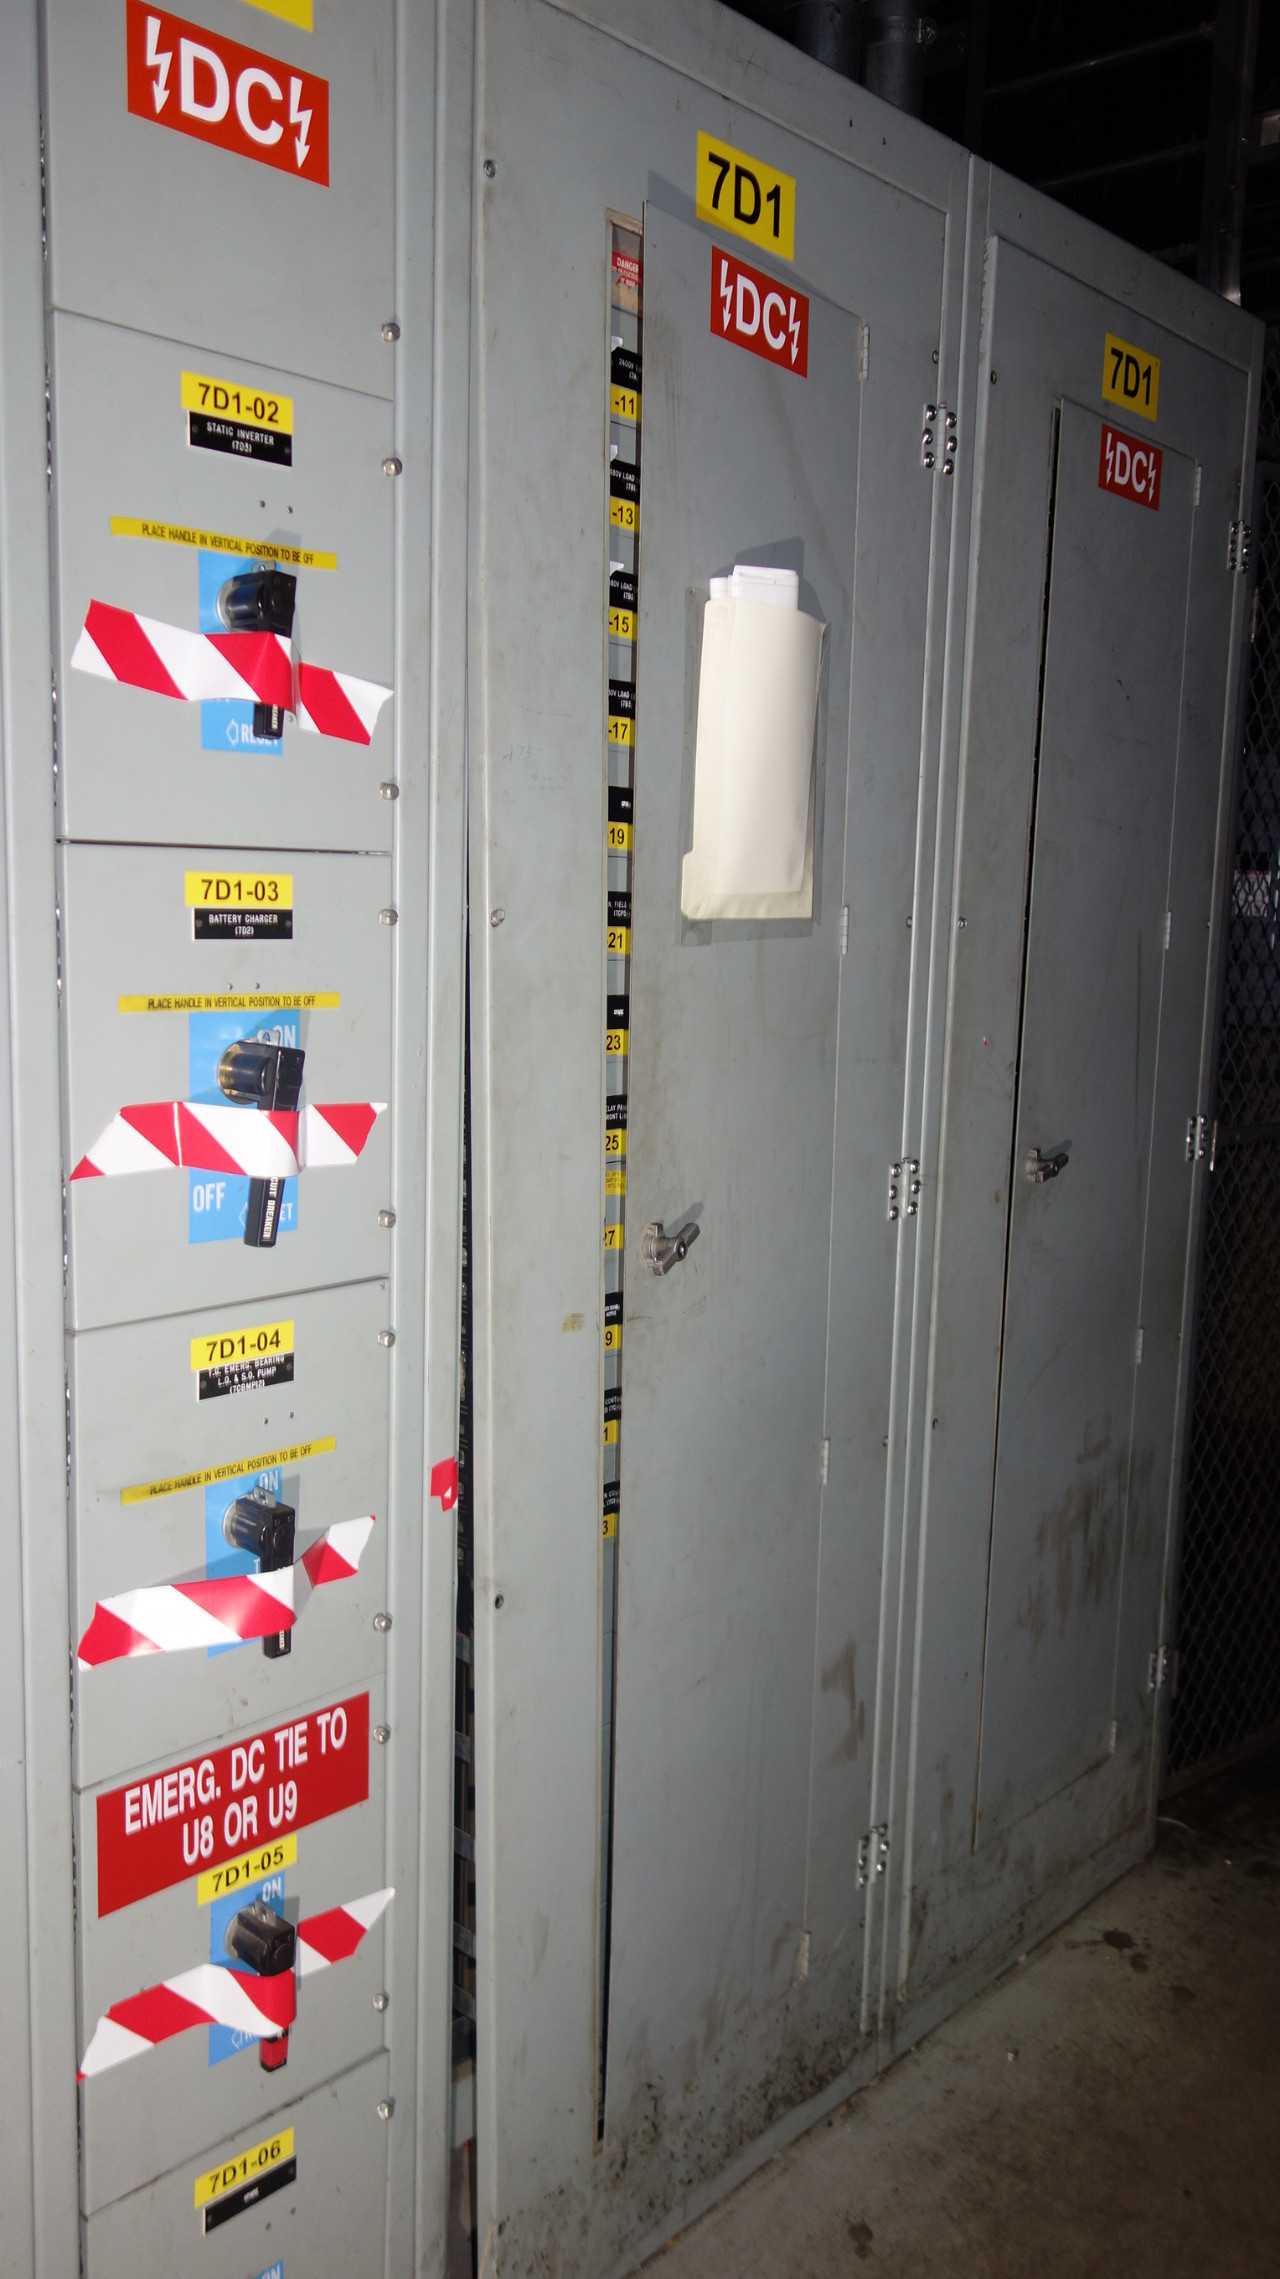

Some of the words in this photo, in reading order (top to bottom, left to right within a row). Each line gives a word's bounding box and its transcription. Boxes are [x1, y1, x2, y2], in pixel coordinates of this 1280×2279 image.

[179, 37, 284, 146] DC
[708, 151, 781, 238] 7D1
[616, 257, 639, 273] DANGER
[735, 273, 787, 351] DC
[1110, 346, 1152, 406] 7D1
[198, 382, 279, 423] 7D1-02
[615, 395, 634, 415] -11
[206, 421, 234, 436] STATIC
[236, 428, 274, 445] INVERTER
[1114, 440, 1147, 493] DC
[612, 504, 633, 525] -13
[141, 523, 165, 538] PLACE
[168, 528, 196, 544] HANDLE
[199, 532, 207, 545] IN
[209, 534, 242, 553] VERTICAL
[245, 541, 278, 559] POSITION
[280, 547, 290, 560] TO
[291, 549, 301, 563] BE
[303, 550, 314, 565] OFF
[201, 879, 279, 901] 7D1-03
[208, 914, 242, 924] BATTERY
[244, 914, 279, 924] CHARGER
[608, 932, 623, 948] 21
[148, 998, 172, 1010] PLACE
[174, 998, 202, 1009] HANDLE
[204, 997, 212, 1008] IN
[214, 997, 246, 1008] VERTICAL
[248, 996, 280, 1008] POSITION
[282, 996, 292, 1006] TO
[293, 996, 302, 1006] BE
[303, 996, 316, 1006] OFF
[192, 1182, 226, 1212] OFF
[263, 1199, 276, 1239] BREAKER
[206, 1328, 281, 1361] 7D1-04
[257, 1367, 277, 1378] PUMP
[150, 1483, 172, 1496] PLACE
[174, 1474, 202, 1489] HANDLE
[204, 1471, 212, 1482] IN
[214, 1464, 245, 1479] VERTICAL
[247, 1457, 277, 1470] POSITION
[279, 1452, 288, 1463] TO
[290, 1448, 299, 1459] BE
[300, 1444, 312, 1456] OFF
[259, 1471, 279, 1491] ON
[124, 1758, 222, 1836] EMERG.
[231, 1738, 265, 1792] DC
[274, 1721, 308, 1773] TIE
[316, 1706, 348, 1755] TO
[183, 1815, 215, 1866] U8
[223, 1794, 258, 1847] OR
[268, 1780, 298, 1828] U9
[212, 1845, 284, 1892] 7D1-05
[262, 1876, 281, 1902] ON
[208, 2140, 281, 2193] 7D1-06
